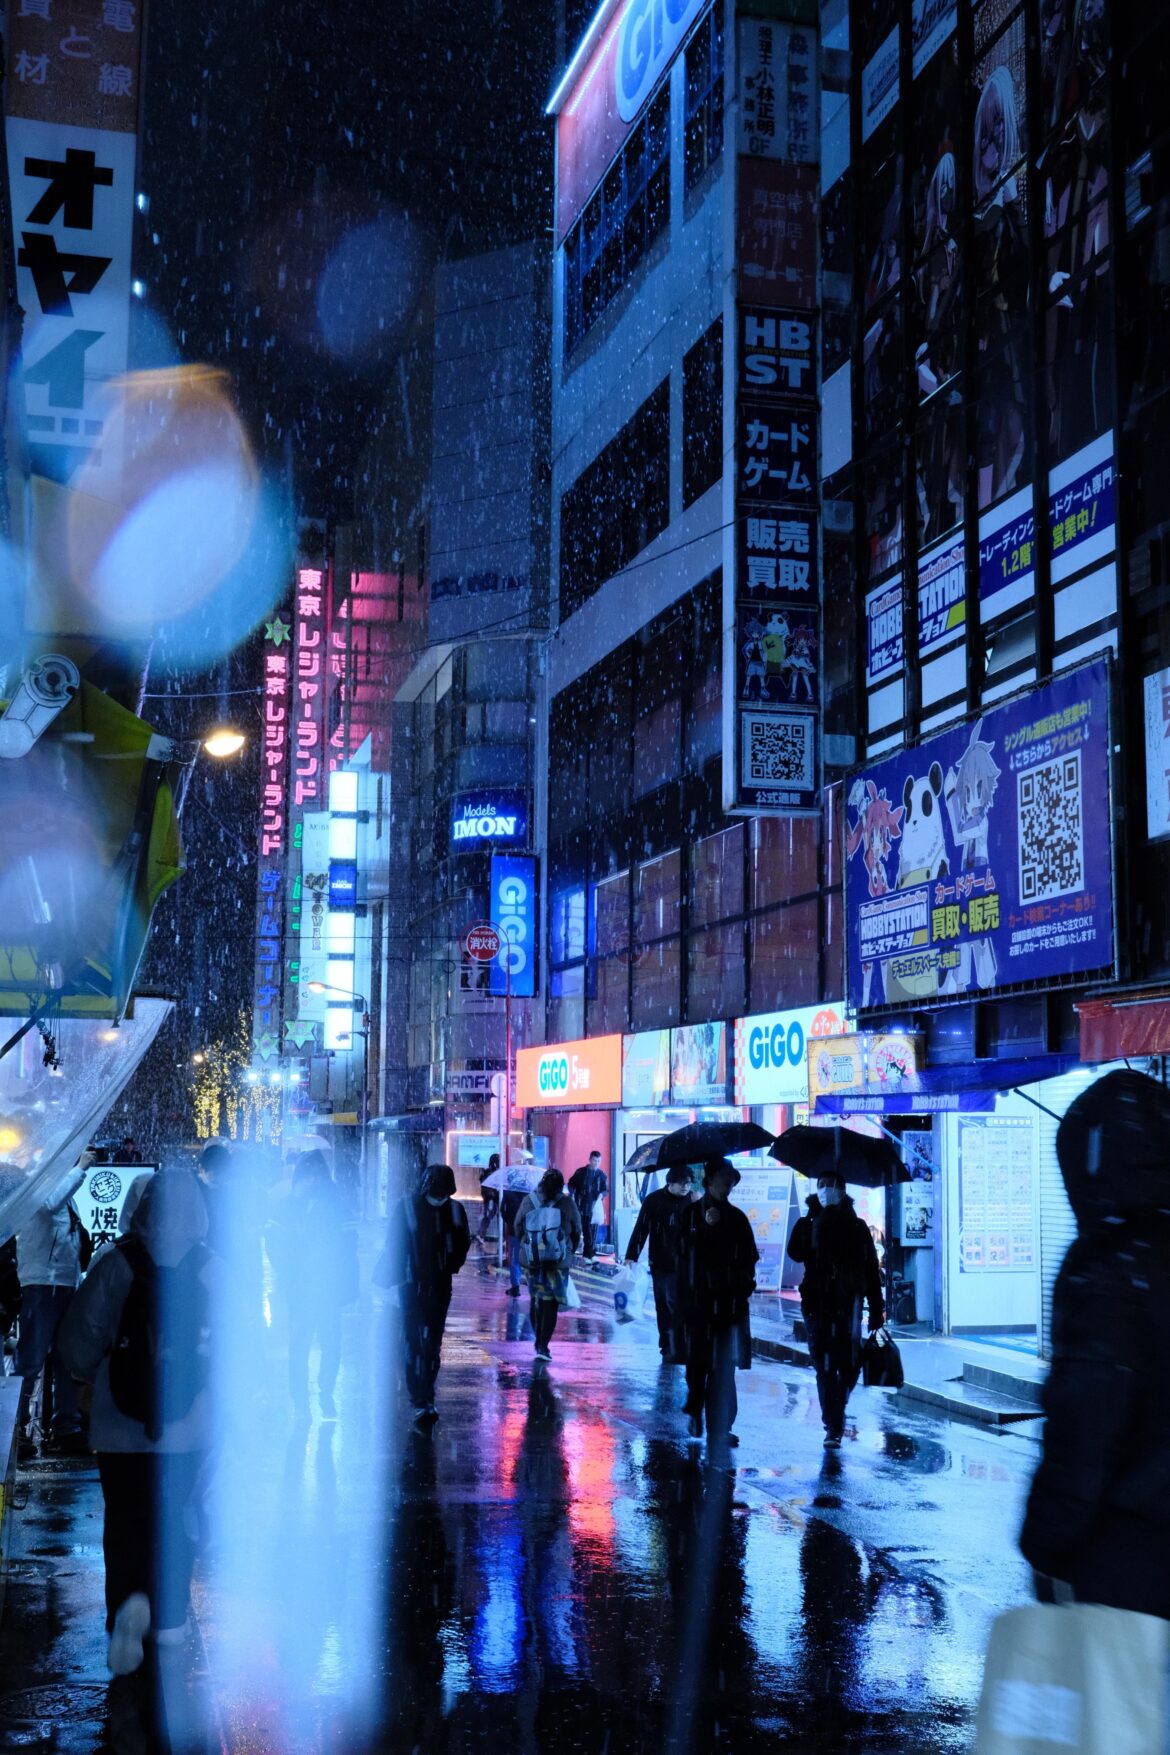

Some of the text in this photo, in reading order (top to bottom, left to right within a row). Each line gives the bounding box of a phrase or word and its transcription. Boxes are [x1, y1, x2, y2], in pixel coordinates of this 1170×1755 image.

[744, 315, 811, 351] HB
[744, 354, 811, 389] ST
[745, 418, 810, 453] カード
[743, 456, 812, 493] ゲーム
[746, 517, 810, 553] 販売
[746, 557, 810, 592] 買取
[918, 565, 966, 622] TATION
[294, 568, 323, 805] 東京レジャーランド
[261, 655, 287, 857] 東京レジャーランド
[453, 816, 517, 840] IMON
[463, 803, 497, 818] Models
[935, 870, 996, 905] カードゲーム
[498, 876, 527, 976] GiGO
[932, 894, 1001, 943] 買取・販売
[257, 870, 281, 1026] ゲームコーナー
[469, 935, 499, 952] 消火栓
[749, 1020, 804, 1070] GiGO
[539, 1054, 568, 1092] GiGO
